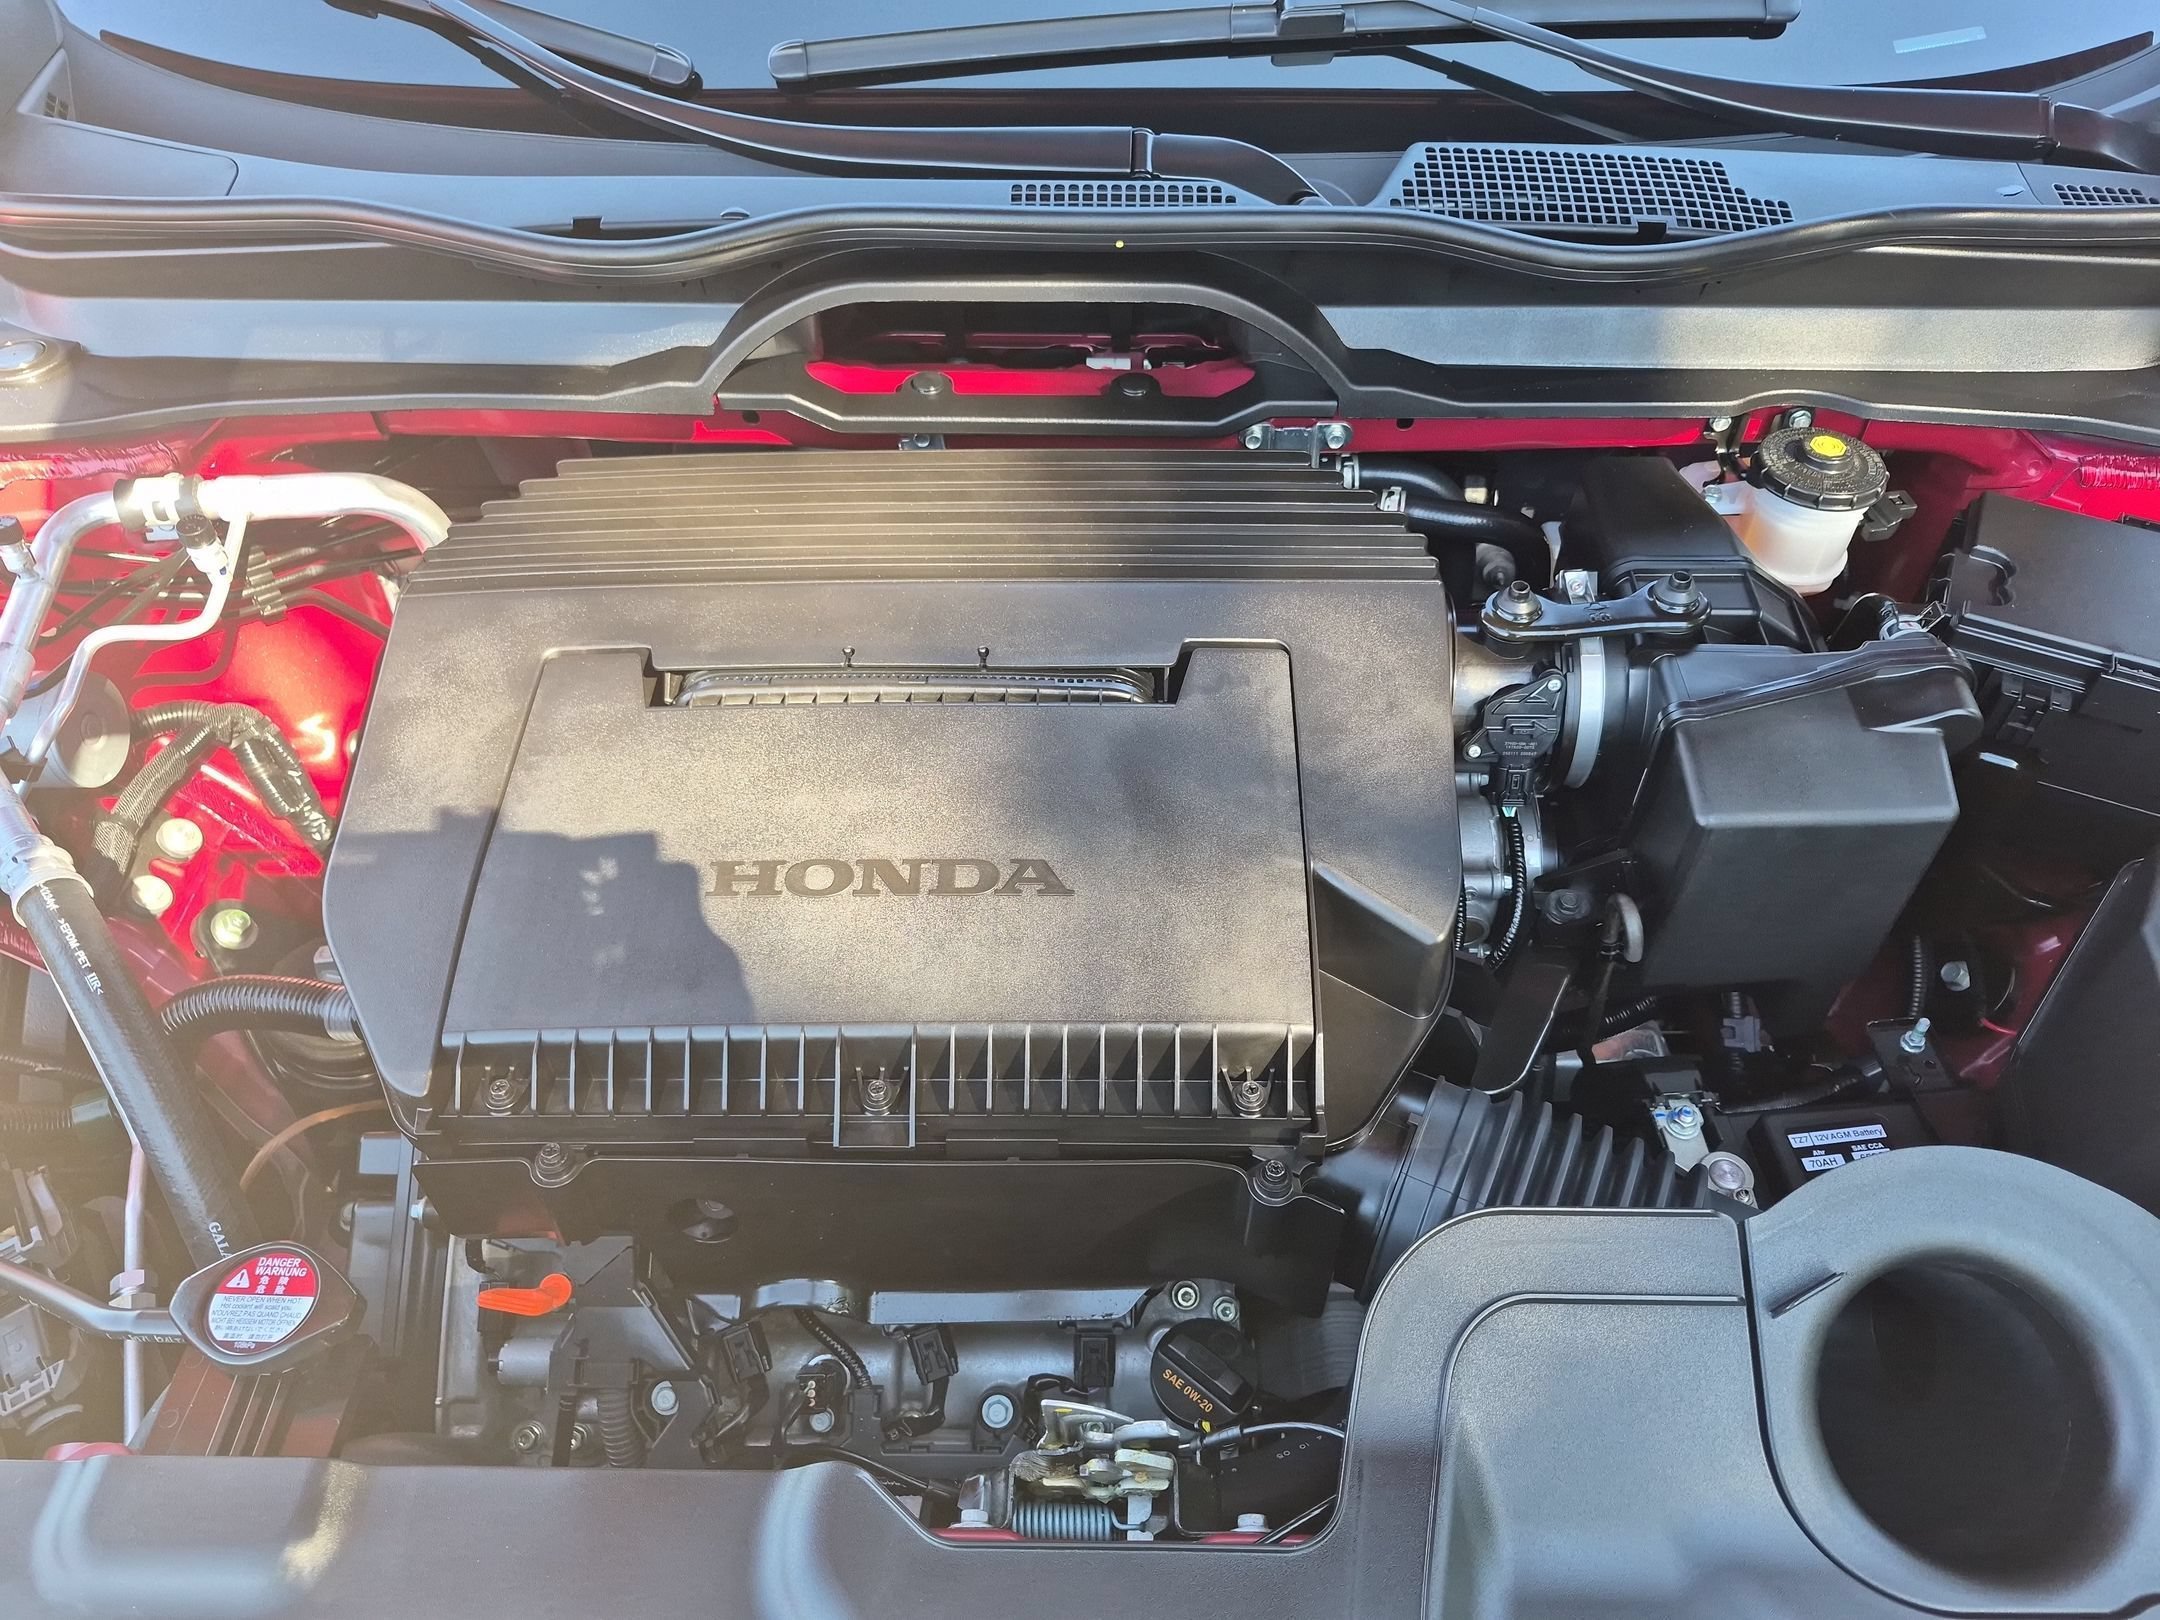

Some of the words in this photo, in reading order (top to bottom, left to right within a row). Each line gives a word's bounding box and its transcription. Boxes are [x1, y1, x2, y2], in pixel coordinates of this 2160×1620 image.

[705, 858, 1075, 897] HONDA
[1853, 1128, 1883, 1138] Battery
[1867, 1142, 1885, 1150] CCA
[1809, 1158, 1838, 1168] 70AH
[258, 1257, 301, 1267] DANGER
[255, 1267, 307, 1276] WARNUNG
[1162, 1369, 1185, 1389] SAE
[1183, 1386, 1213, 1412] 0W-20
